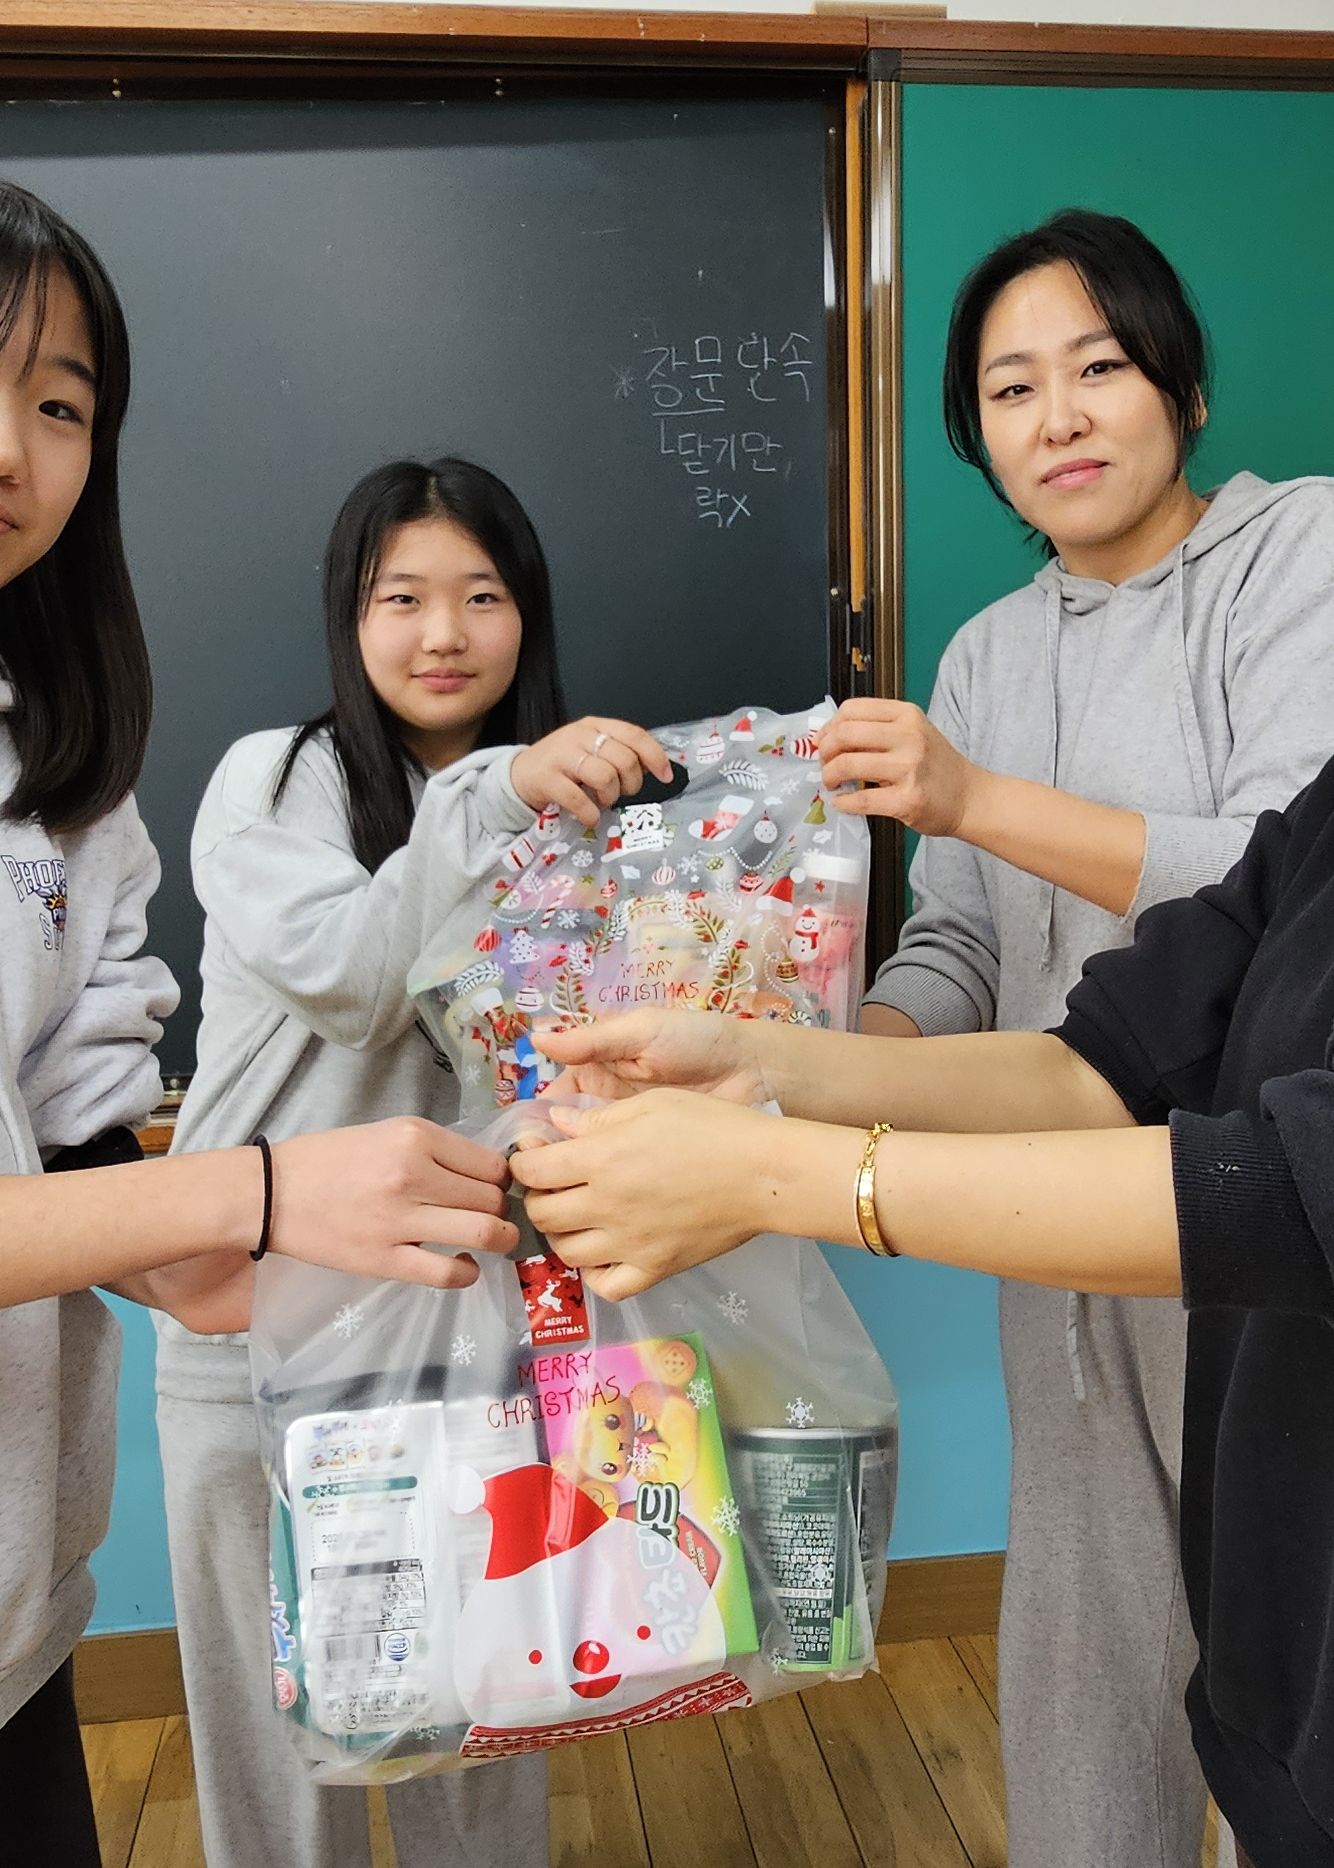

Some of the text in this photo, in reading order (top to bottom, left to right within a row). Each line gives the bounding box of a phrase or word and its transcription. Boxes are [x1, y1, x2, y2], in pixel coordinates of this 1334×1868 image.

[620, 959, 675, 979] MERRY
[598, 980, 700, 1003] CHRISTMAS
[534, 1324, 585, 1339] CHRISTMAS
[543, 1315, 573, 1327] MERRY
[517, 1350, 593, 1388] MERRY
[486, 1374, 621, 1429] CHRISTMAS
